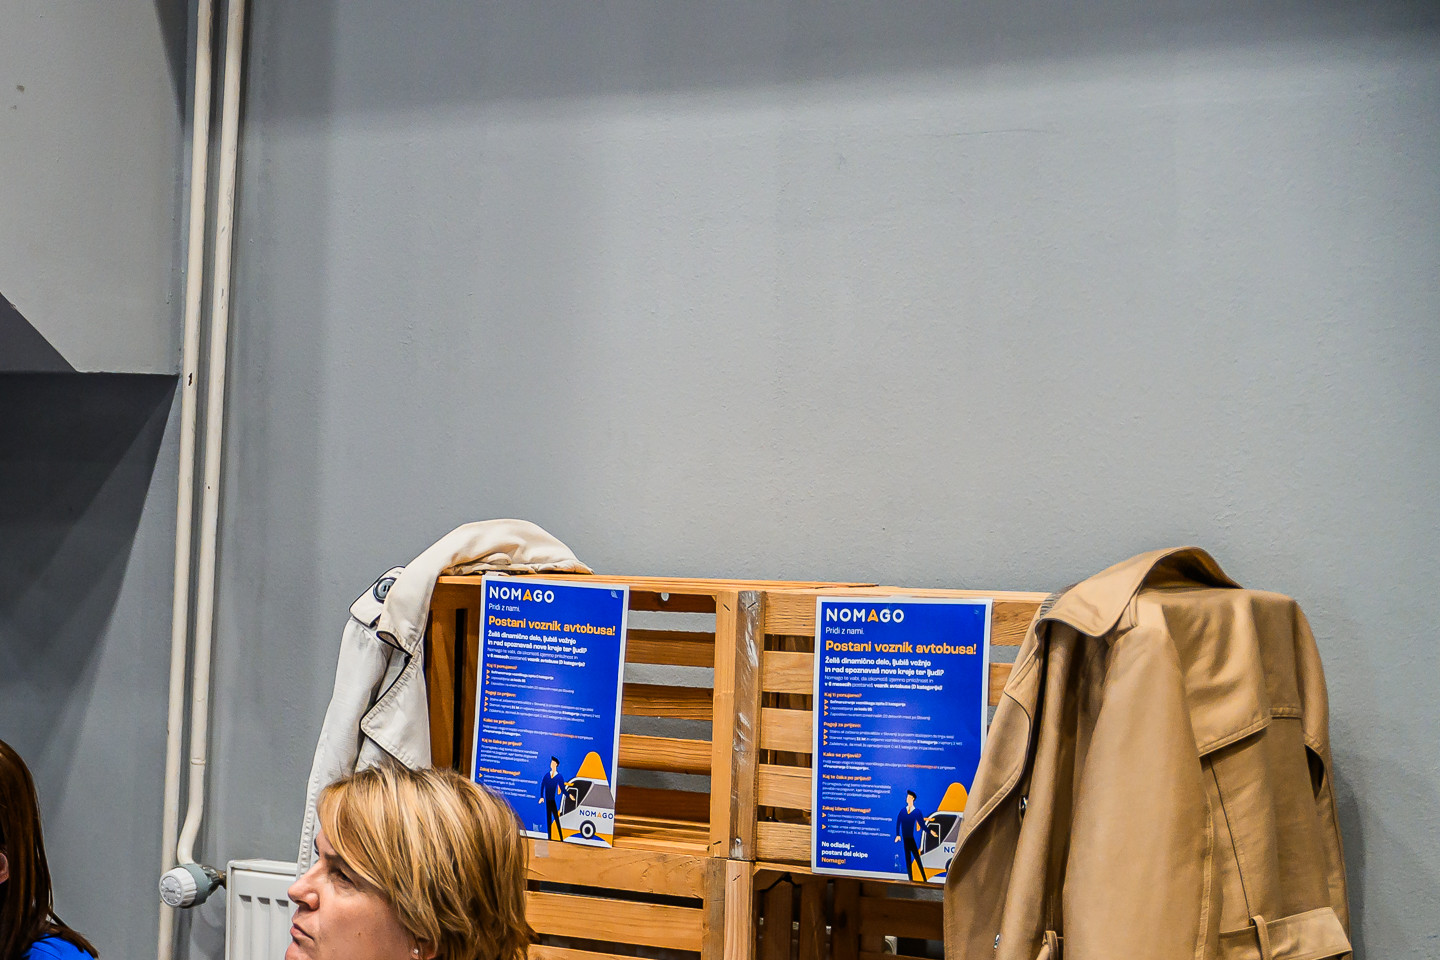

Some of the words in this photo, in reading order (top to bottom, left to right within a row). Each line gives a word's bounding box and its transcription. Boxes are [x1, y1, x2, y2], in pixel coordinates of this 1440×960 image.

[489, 586, 555, 604] NOMAGO
[826, 608, 905, 624] NOMAGO
[488, 615, 527, 628] Postani
[528, 620, 562, 632] voznik
[563, 623, 616, 636] avtobusa!
[825, 626, 840, 635] Pridi
[846, 627, 864, 635] nami.
[825, 640, 872, 653] Postani
[874, 641, 913, 653] voznik
[915, 642, 977, 655] avtobusa!
[825, 656, 840, 665] Želiš
[841, 656, 875, 665] dinamično
[875, 657, 892, 666] delo,
[832, 666, 844, 674] rad
[844, 666, 880, 676] spoznavaš
[926, 669, 944, 677] ljudi?
[579, 809, 614, 820] NOMAGO
[821, 857, 846, 865] Nomago!
